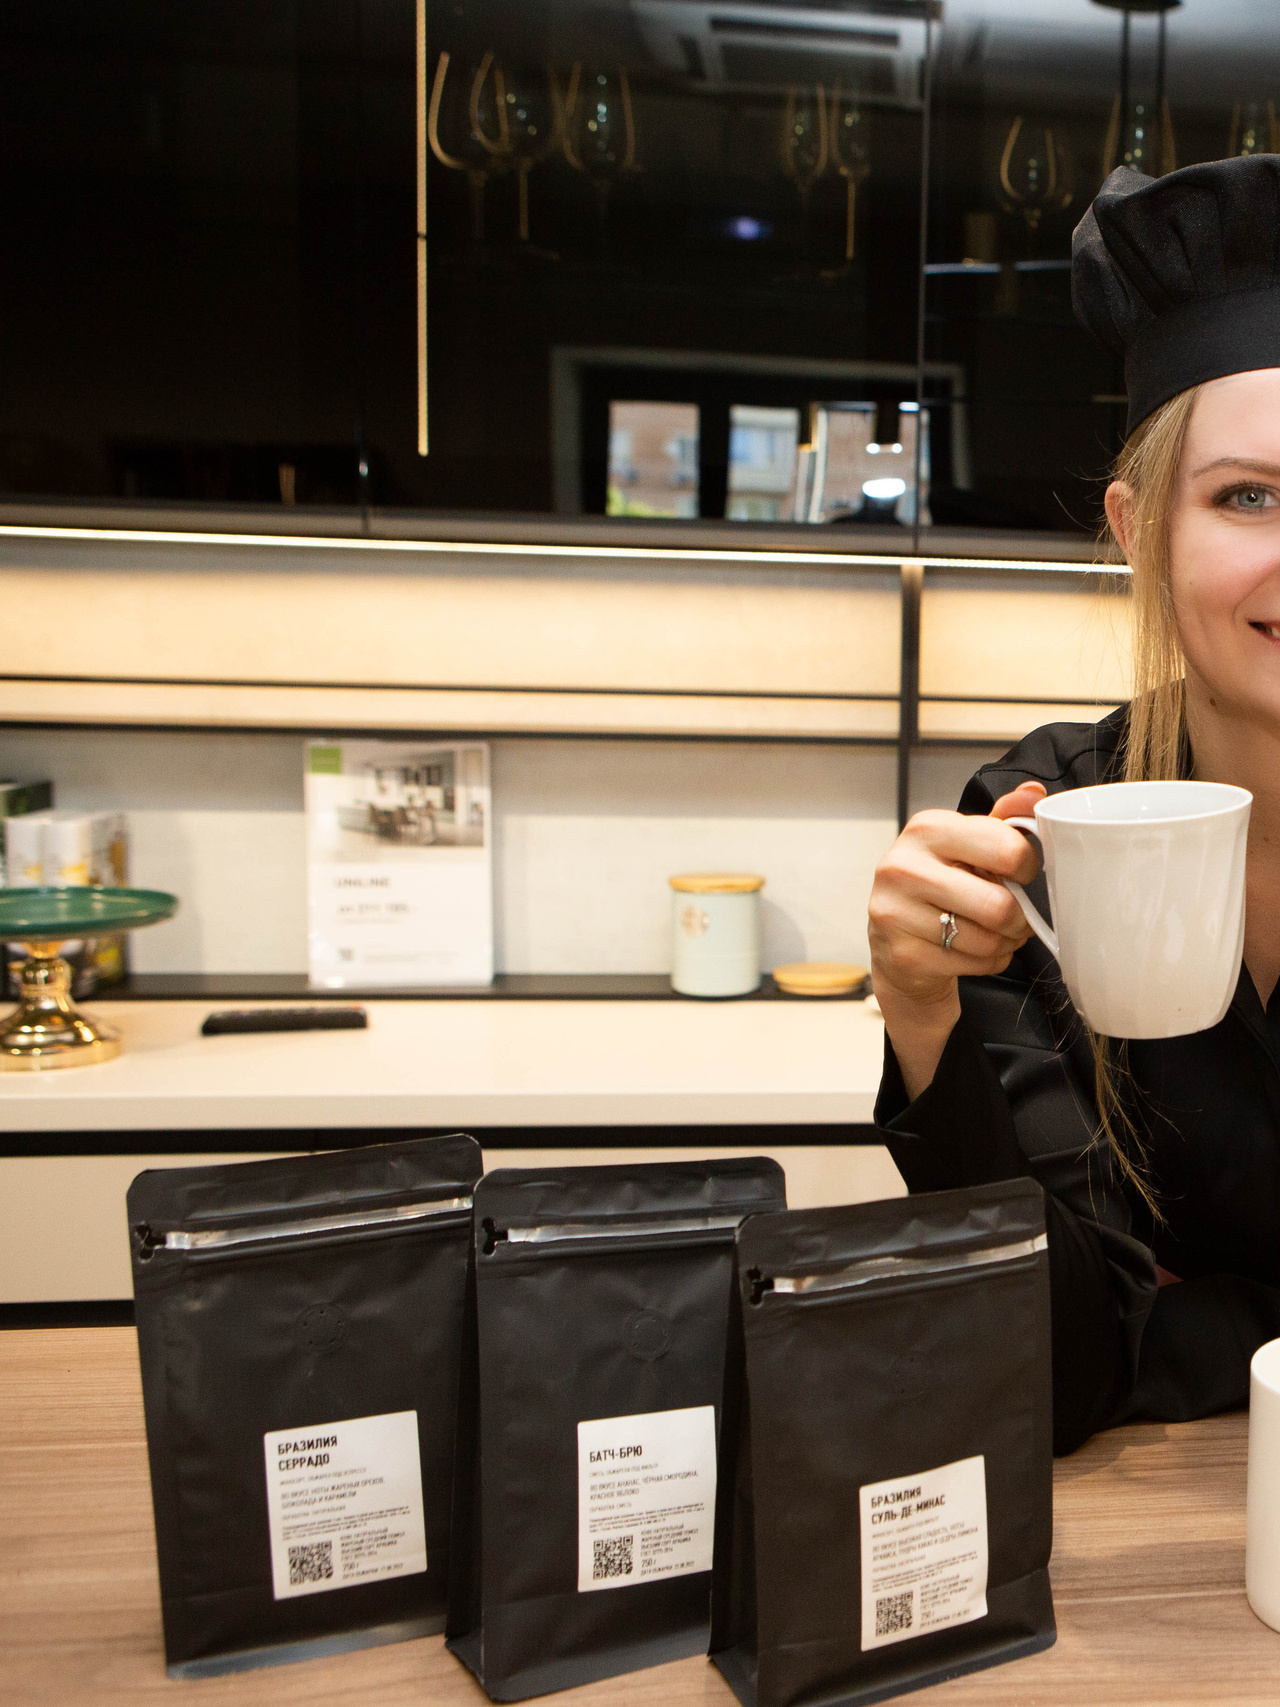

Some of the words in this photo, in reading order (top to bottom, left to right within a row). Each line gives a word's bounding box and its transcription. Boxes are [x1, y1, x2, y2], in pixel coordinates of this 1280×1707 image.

[277, 1435, 338, 1455] БРАЗИЛИЯ
[589, 1445, 643, 1463] БАТЧ-БРЮ
[278, 1453, 330, 1472] СЕРРАДО
[290, 1488, 309, 1498] ВКУСЕ
[310, 1485, 329, 1495] НОТЫ
[590, 1484, 597, 1492] ВО
[599, 1481, 615, 1491] ВКУСЕ
[590, 1491, 614, 1501] КРАСНОЕ
[616, 1487, 639, 1497] ЯБЛОКО
[318, 1495, 322, 1503] И
[324, 1489, 356, 1502] КАРАМЕЛИ
[871, 1486, 922, 1508] БРАЗИЛИЯ
[871, 1495, 946, 1525] СУЛЬ-ДЕ-МИНАС
